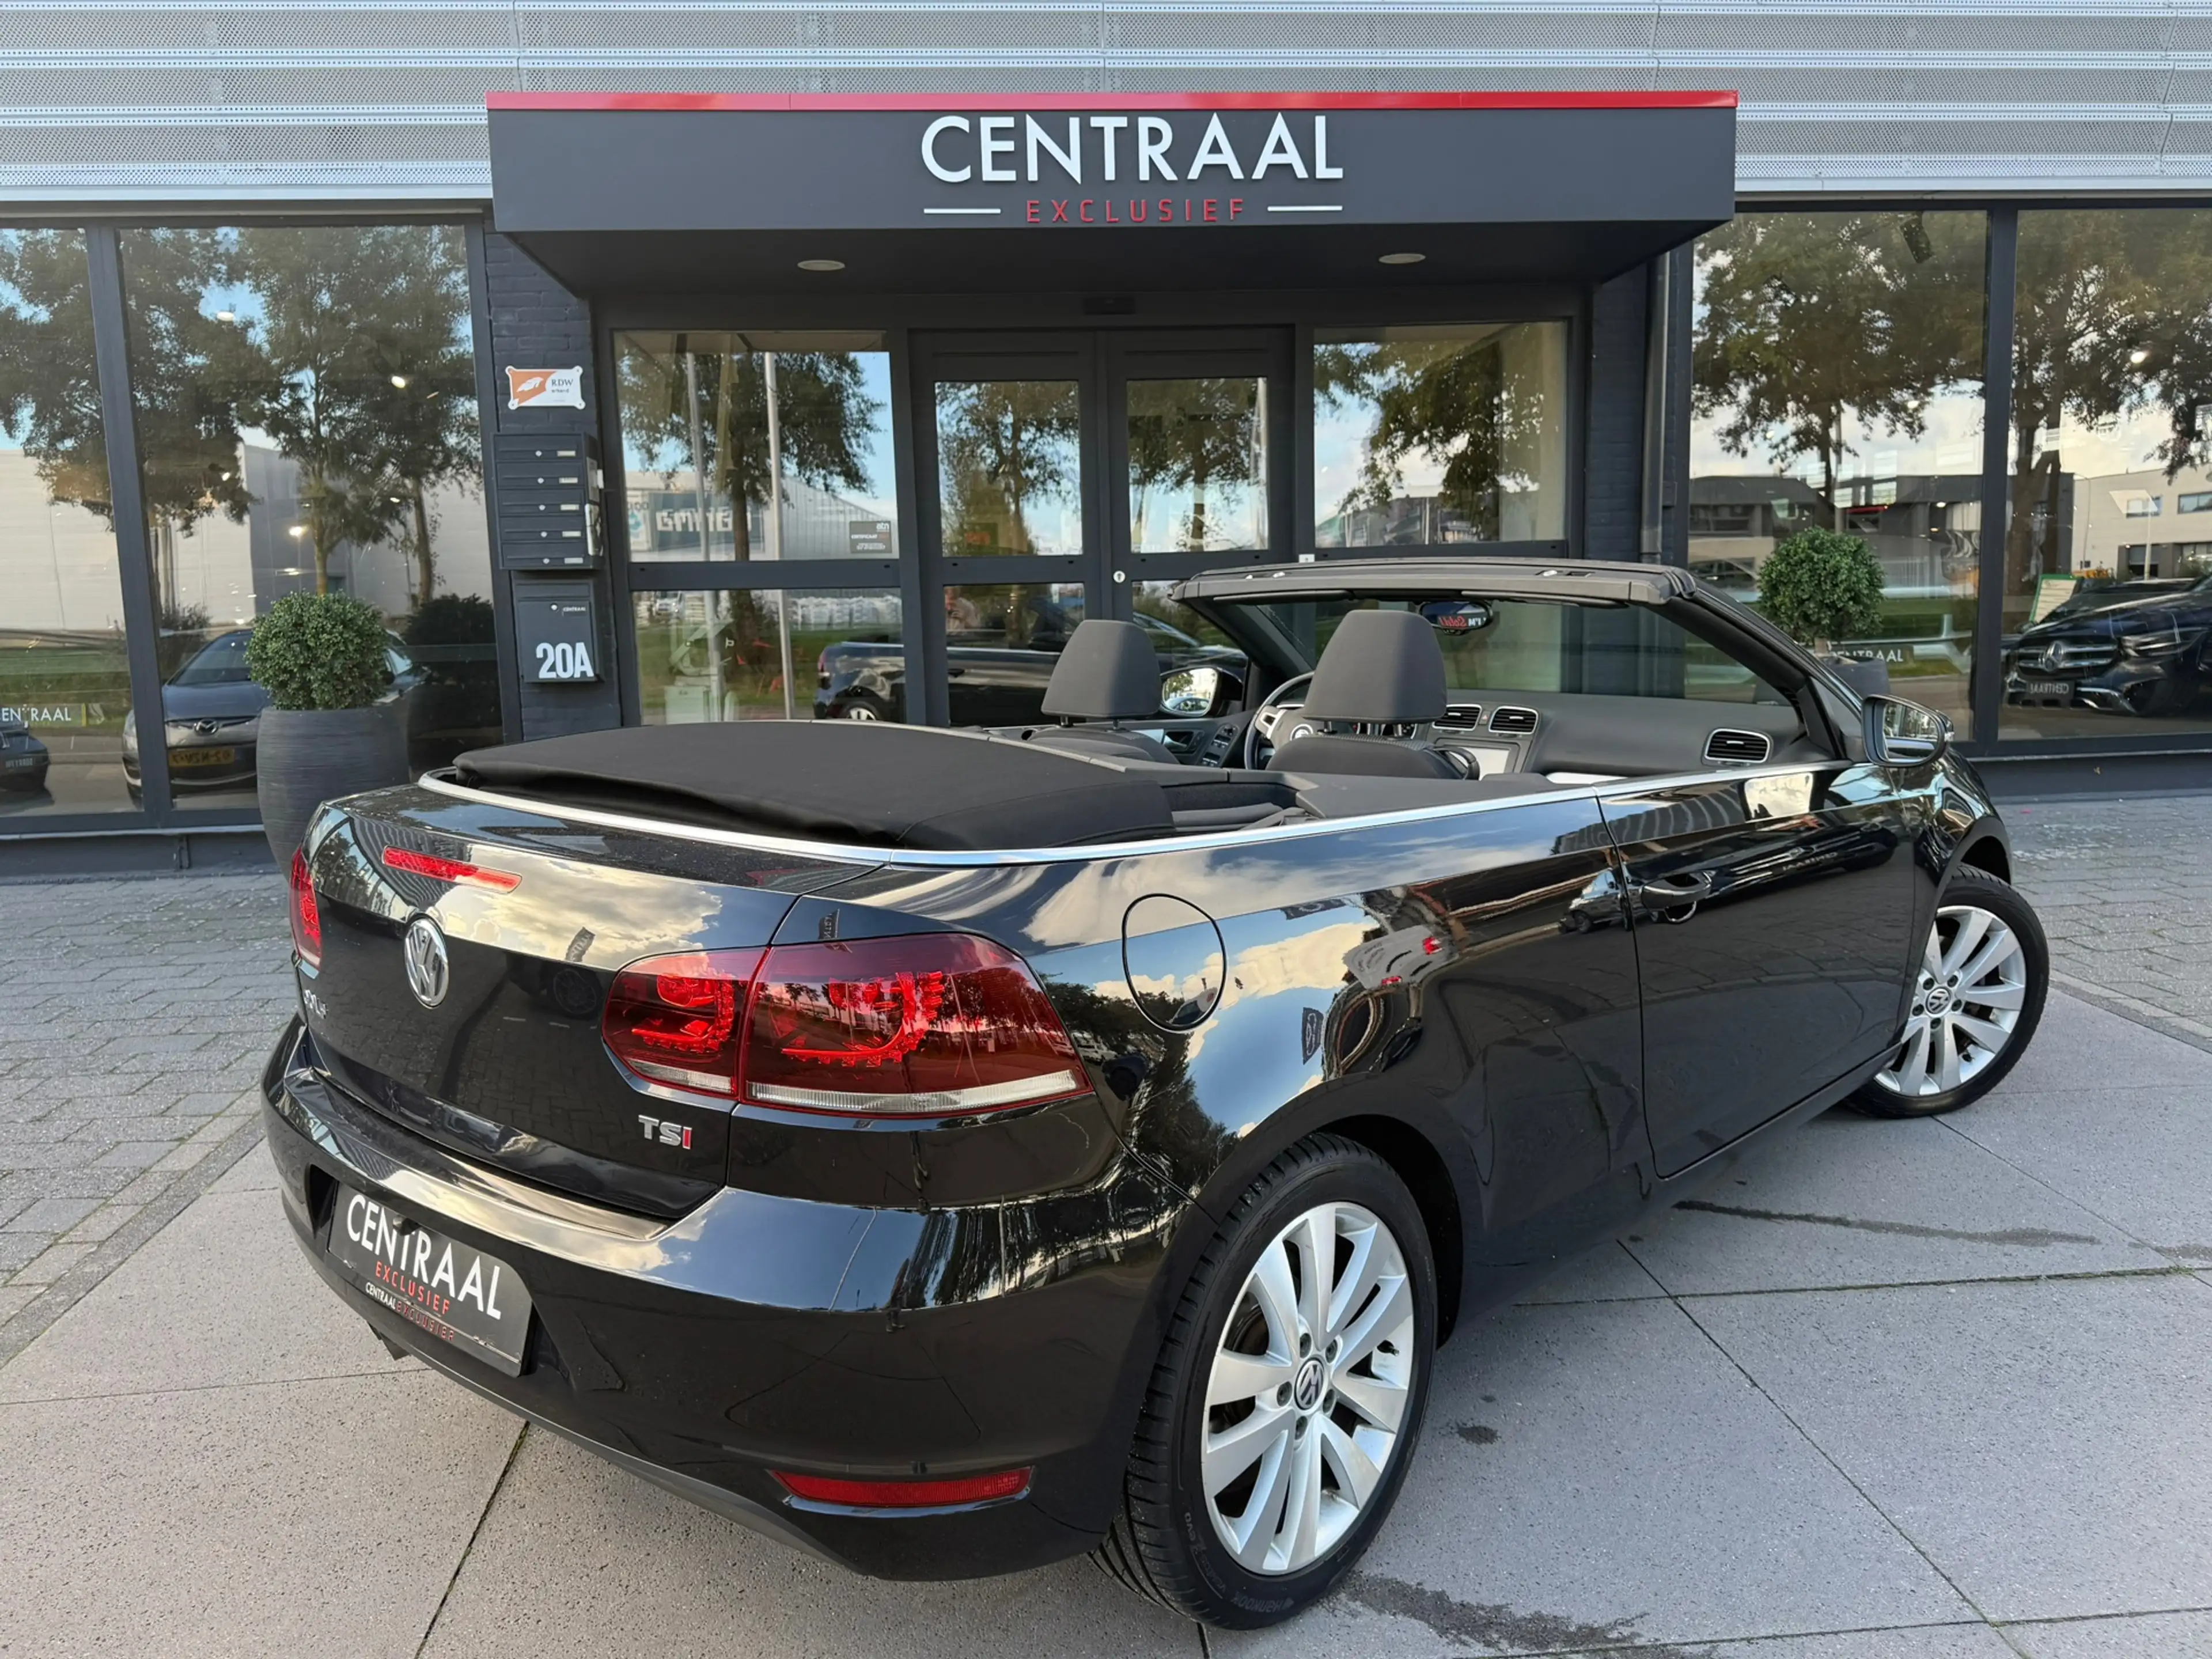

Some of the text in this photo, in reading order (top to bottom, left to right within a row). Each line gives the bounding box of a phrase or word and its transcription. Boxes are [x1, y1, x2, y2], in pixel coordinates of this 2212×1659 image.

[921, 112, 1343, 184] CENTRAAL
[1026, 198, 1244, 223] EXCLUSIEF
[551, 378, 574, 387] RDW
[536, 642, 594, 679] 20A
[638, 1114, 692, 1150] TSI
[347, 1195, 501, 1320] CENTRAAL
[376, 1261, 450, 1316] EXCLUSIEF
